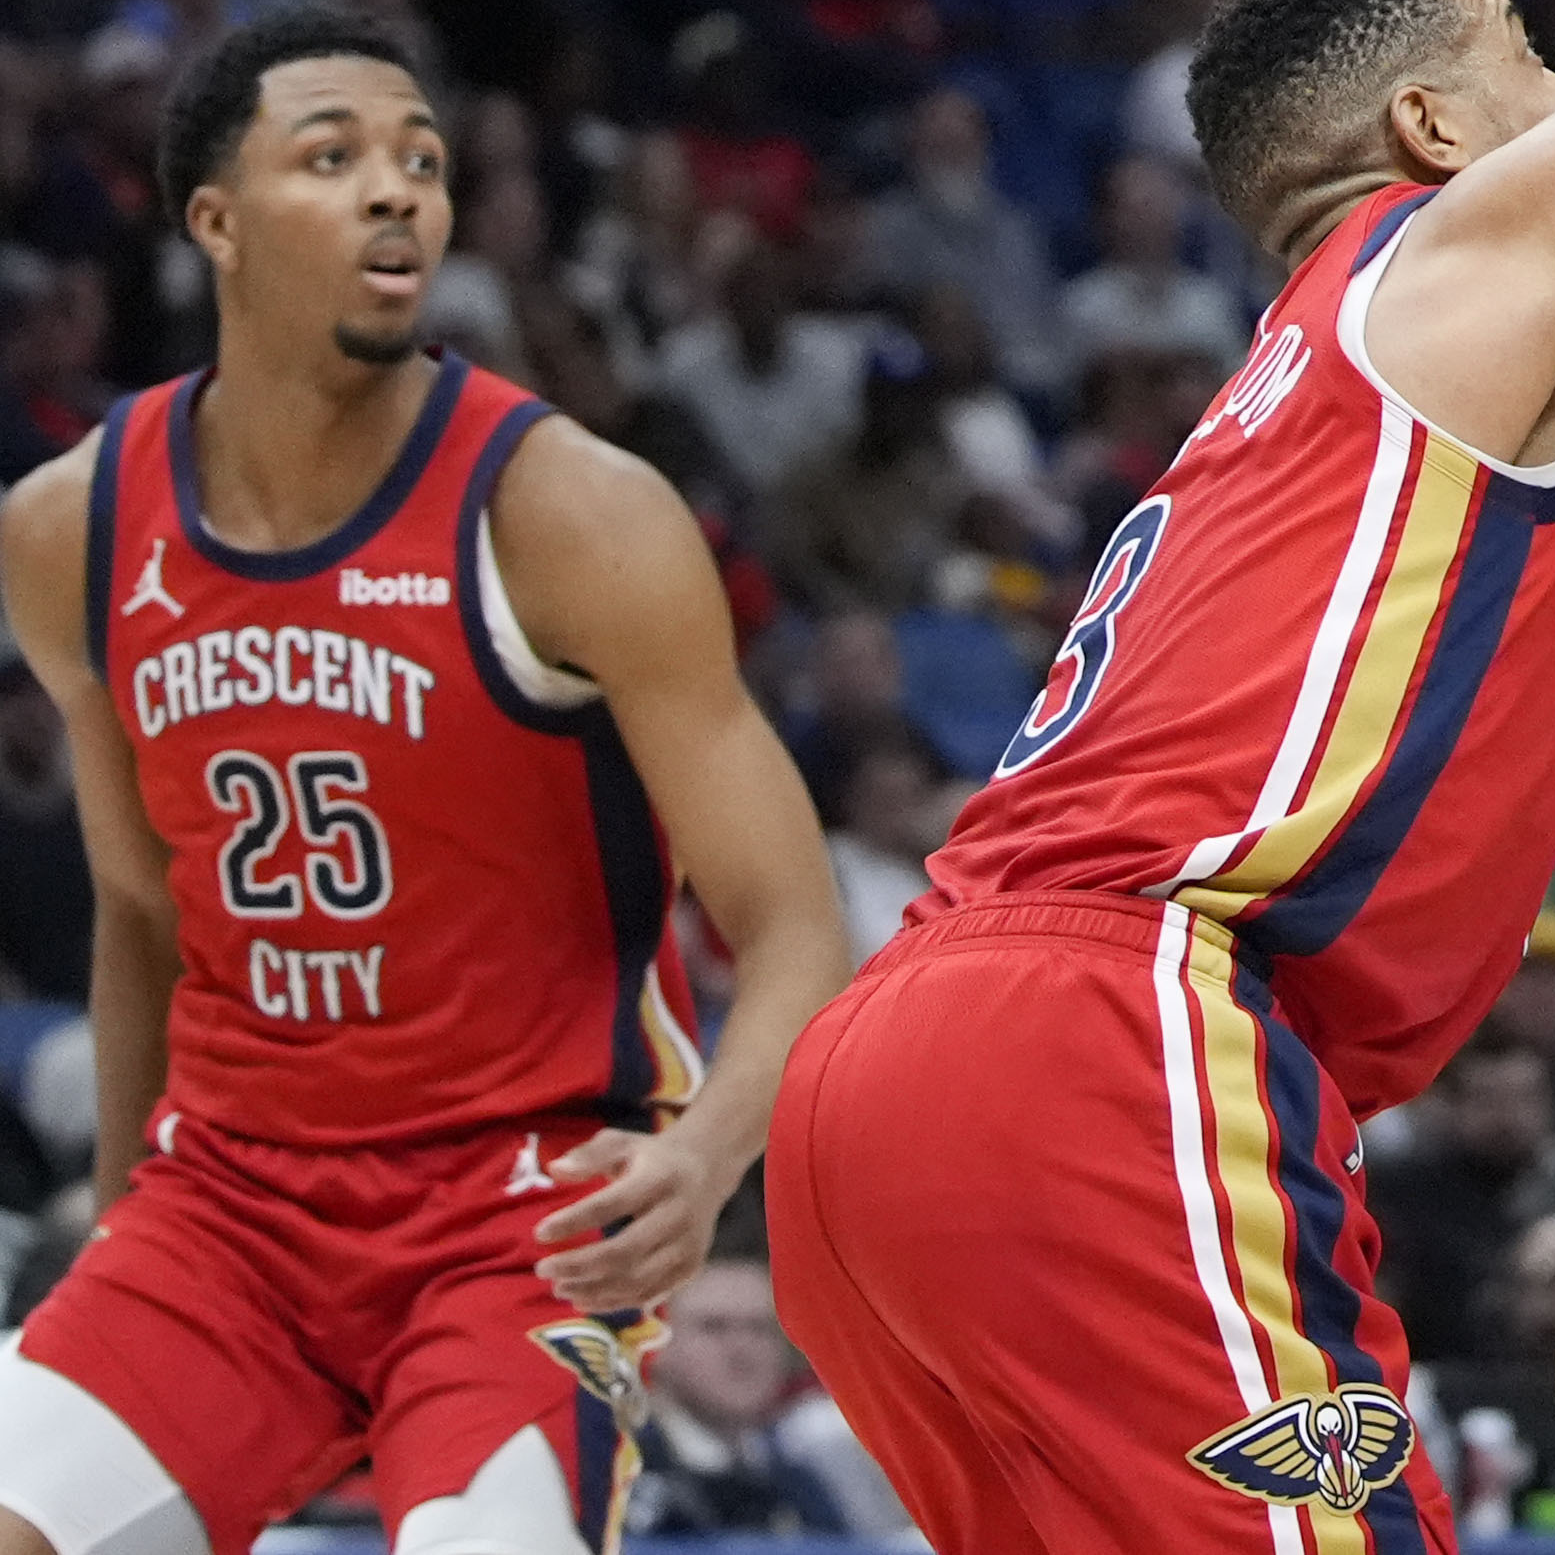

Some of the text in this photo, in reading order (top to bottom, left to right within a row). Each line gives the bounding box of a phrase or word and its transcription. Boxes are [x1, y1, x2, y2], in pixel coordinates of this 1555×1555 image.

[338, 569, 450, 607] ibotta
[993, 492, 1172, 780] 3
[132, 624, 434, 741] CRESCENT
[204, 749, 393, 920] 25
[248, 938, 384, 1022] CITY
